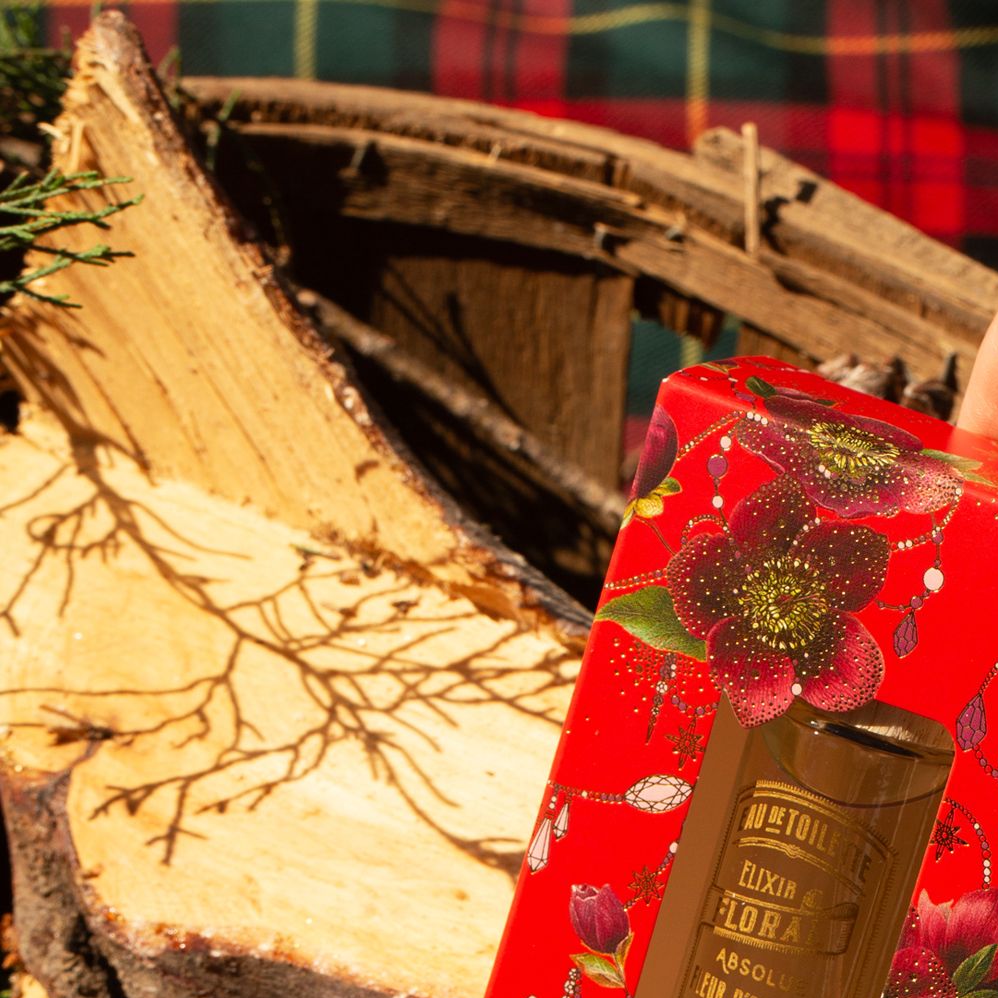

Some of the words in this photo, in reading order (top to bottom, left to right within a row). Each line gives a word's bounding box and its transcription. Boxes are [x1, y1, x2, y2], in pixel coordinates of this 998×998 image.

[768, 805, 786, 825] DE
[738, 859, 797, 900] ELIXIR
[713, 896, 819, 945] FLORAL
